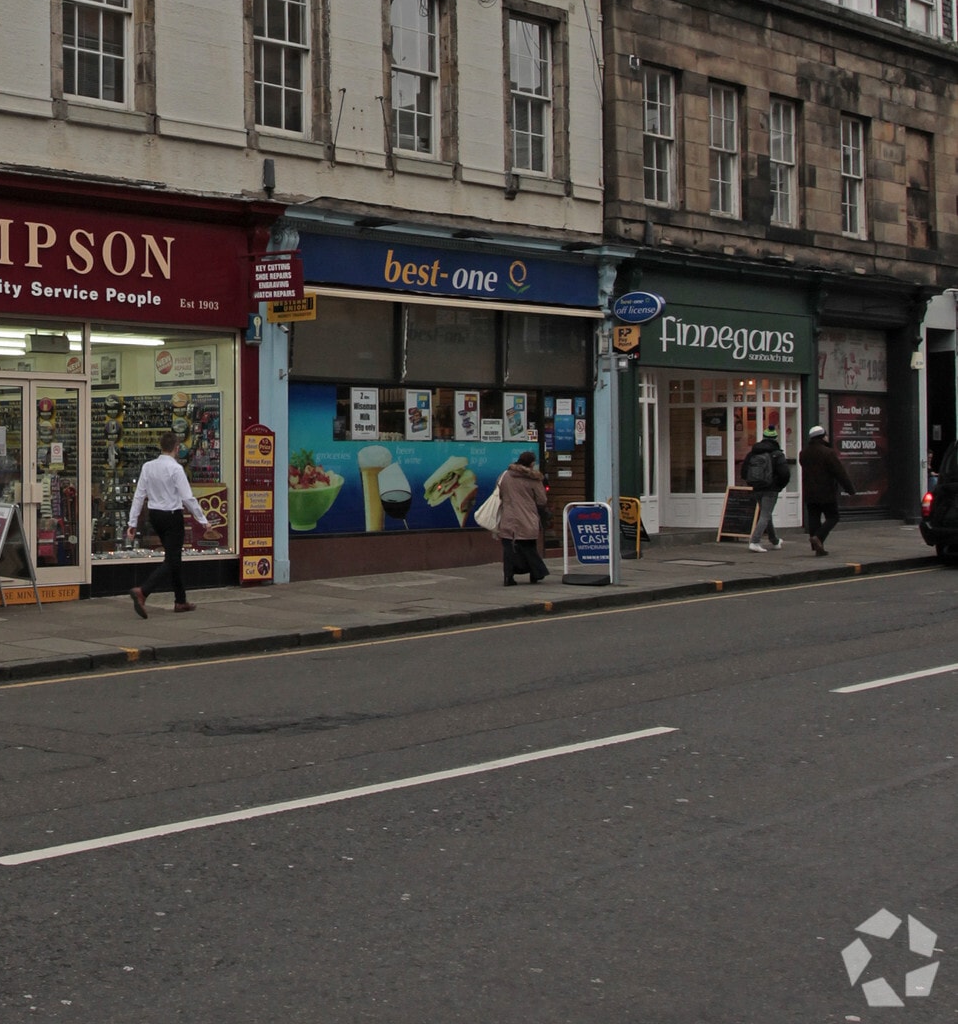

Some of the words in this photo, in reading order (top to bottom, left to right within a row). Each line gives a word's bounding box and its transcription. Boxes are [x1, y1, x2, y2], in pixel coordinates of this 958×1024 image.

[255, 264, 266, 272] KEY
[267, 263, 291, 271] CUTTING
[255, 273, 269, 281] SHOE
[258, 281, 289, 289] ENGRAVING
[31, 281, 98, 301] Service
[106, 287, 161, 308] People
[180, 298, 195, 309] Est
[199, 299, 219, 311] 1903
[283, 304, 307, 312] UNION
[628, 306, 656, 314] license
[155, 355, 172, 368] NEW
[316, 451, 351, 462] groceries
[260, 458, 271, 466] Keys
[577, 524, 608, 534] FREE
[580, 534, 610, 544] CASH
[42, 589, 55, 598] THE
[58, 589, 76, 597] STEP
